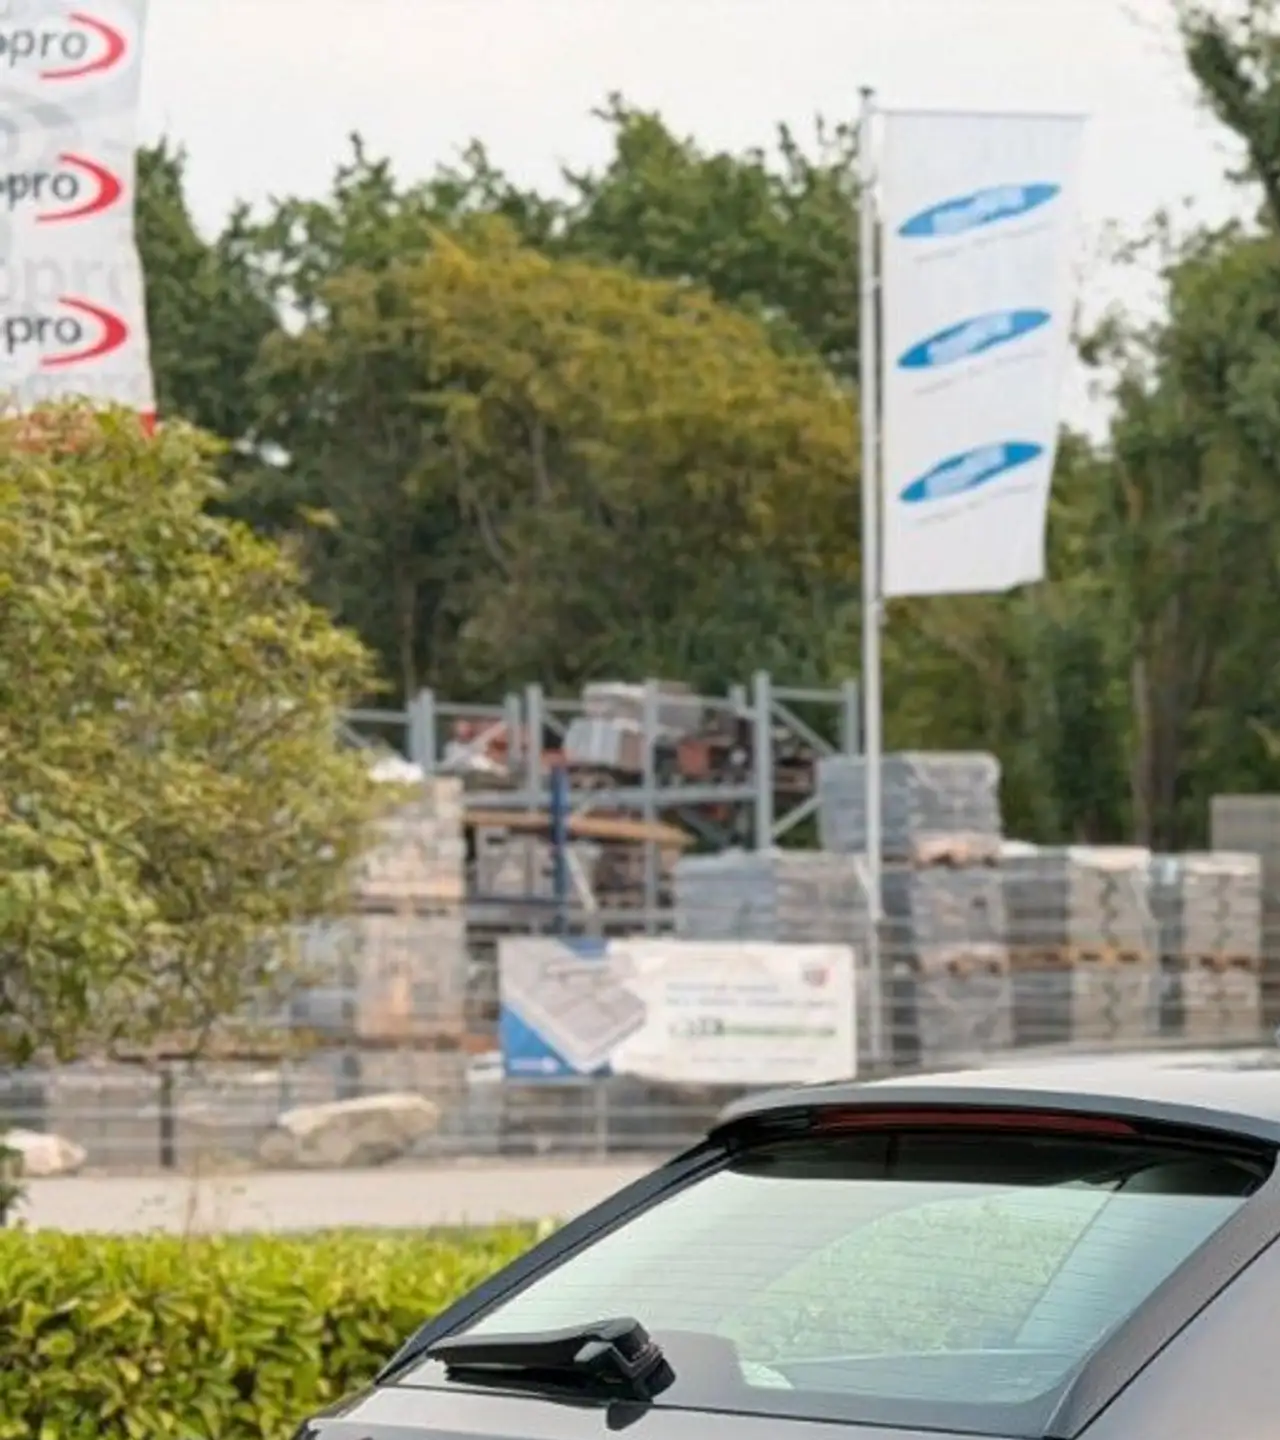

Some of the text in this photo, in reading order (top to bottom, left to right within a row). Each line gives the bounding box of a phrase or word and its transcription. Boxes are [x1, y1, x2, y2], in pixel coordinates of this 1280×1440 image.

[0, 28, 88, 68] pro
[0, 170, 80, 210] pro
[0, 312, 83, 354] pro
